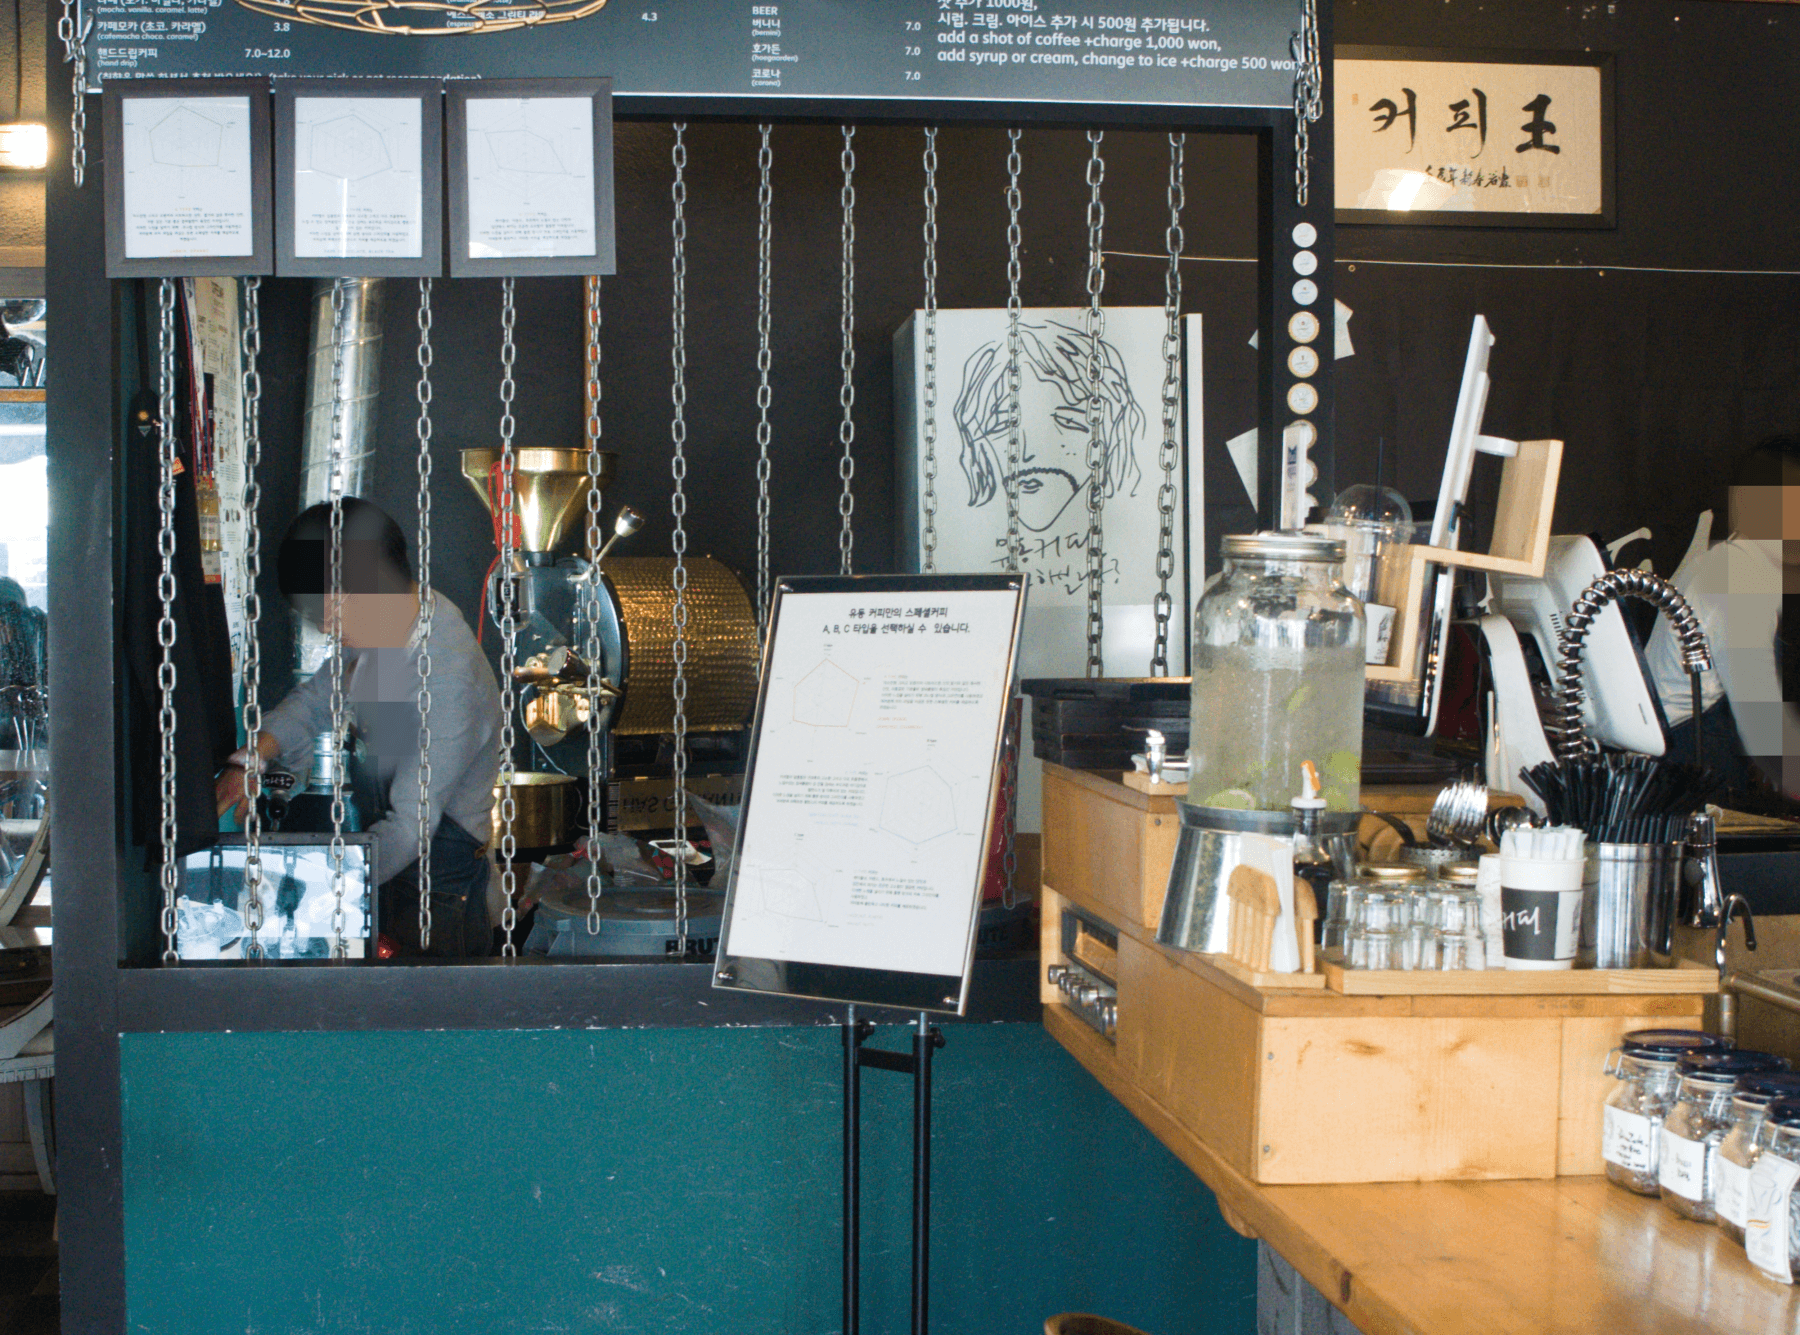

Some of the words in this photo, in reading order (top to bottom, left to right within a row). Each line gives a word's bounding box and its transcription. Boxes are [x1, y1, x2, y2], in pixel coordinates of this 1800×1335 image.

[752, 6, 778, 15] BEER
[641, 12, 658, 21] 4.3
[97, 21, 138, 32] 카페모카
[171, 21, 206, 33] 카라멜)
[273, 22, 290, 32] 3.8
[752, 19, 781, 28] 버니니
[905, 22, 921, 31] 7.0
[1006, 14, 1047, 28] 아이스
[1050, 15, 1077, 30] 추가
[1081, 16, 1094, 29] 시
[1098, 16, 1136, 32] 500원
[1140, 17, 1210, 33] 추가됩니다.
[937, 30, 966, 44] add
[969, 33, 978, 44] a
[982, 31, 1014, 45] shot
[1017, 32, 1032, 45] of
[1035, 33, 1080, 46] coffee
[1084, 34, 1142, 51] +charge
[1145, 36, 1184, 51] 1,000
[1187, 39, 1222, 52] won,
[97, 48, 158, 59] 핸드드립커피
[244, 48, 291, 59] 7.0~12.0
[752, 43, 781, 54] 호가든
[905, 46, 921, 56] 7.0
[120, 60, 138, 68] drip)
[937, 49, 966, 61] add
[969, 50, 1008, 65] syrup
[1011, 53, 1026, 63] or
[1030, 53, 1078, 66] cream,
[1082, 51, 1135, 69] change
[1138, 54, 1153, 66] to
[1156, 53, 1177, 67] ice
[1181, 54, 1238, 72] +charge
[1241, 57, 1267, 70] 500
[751, 68, 781, 79] 코로나
[904, 71, 921, 80] 7.0
[751, 79, 781, 87] (corona)
[848, 608, 865, 619] 유동
[868, 608, 902, 619] 커피만의
[822, 624, 831, 635] A,
[833, 624, 841, 635] B,
[843, 624, 850, 634] C
[853, 624, 877, 635] 타입을
[880, 622, 914, 634] 선택하실
[917, 623, 926, 634] 수
[933, 622, 971, 634] 있습니다.
